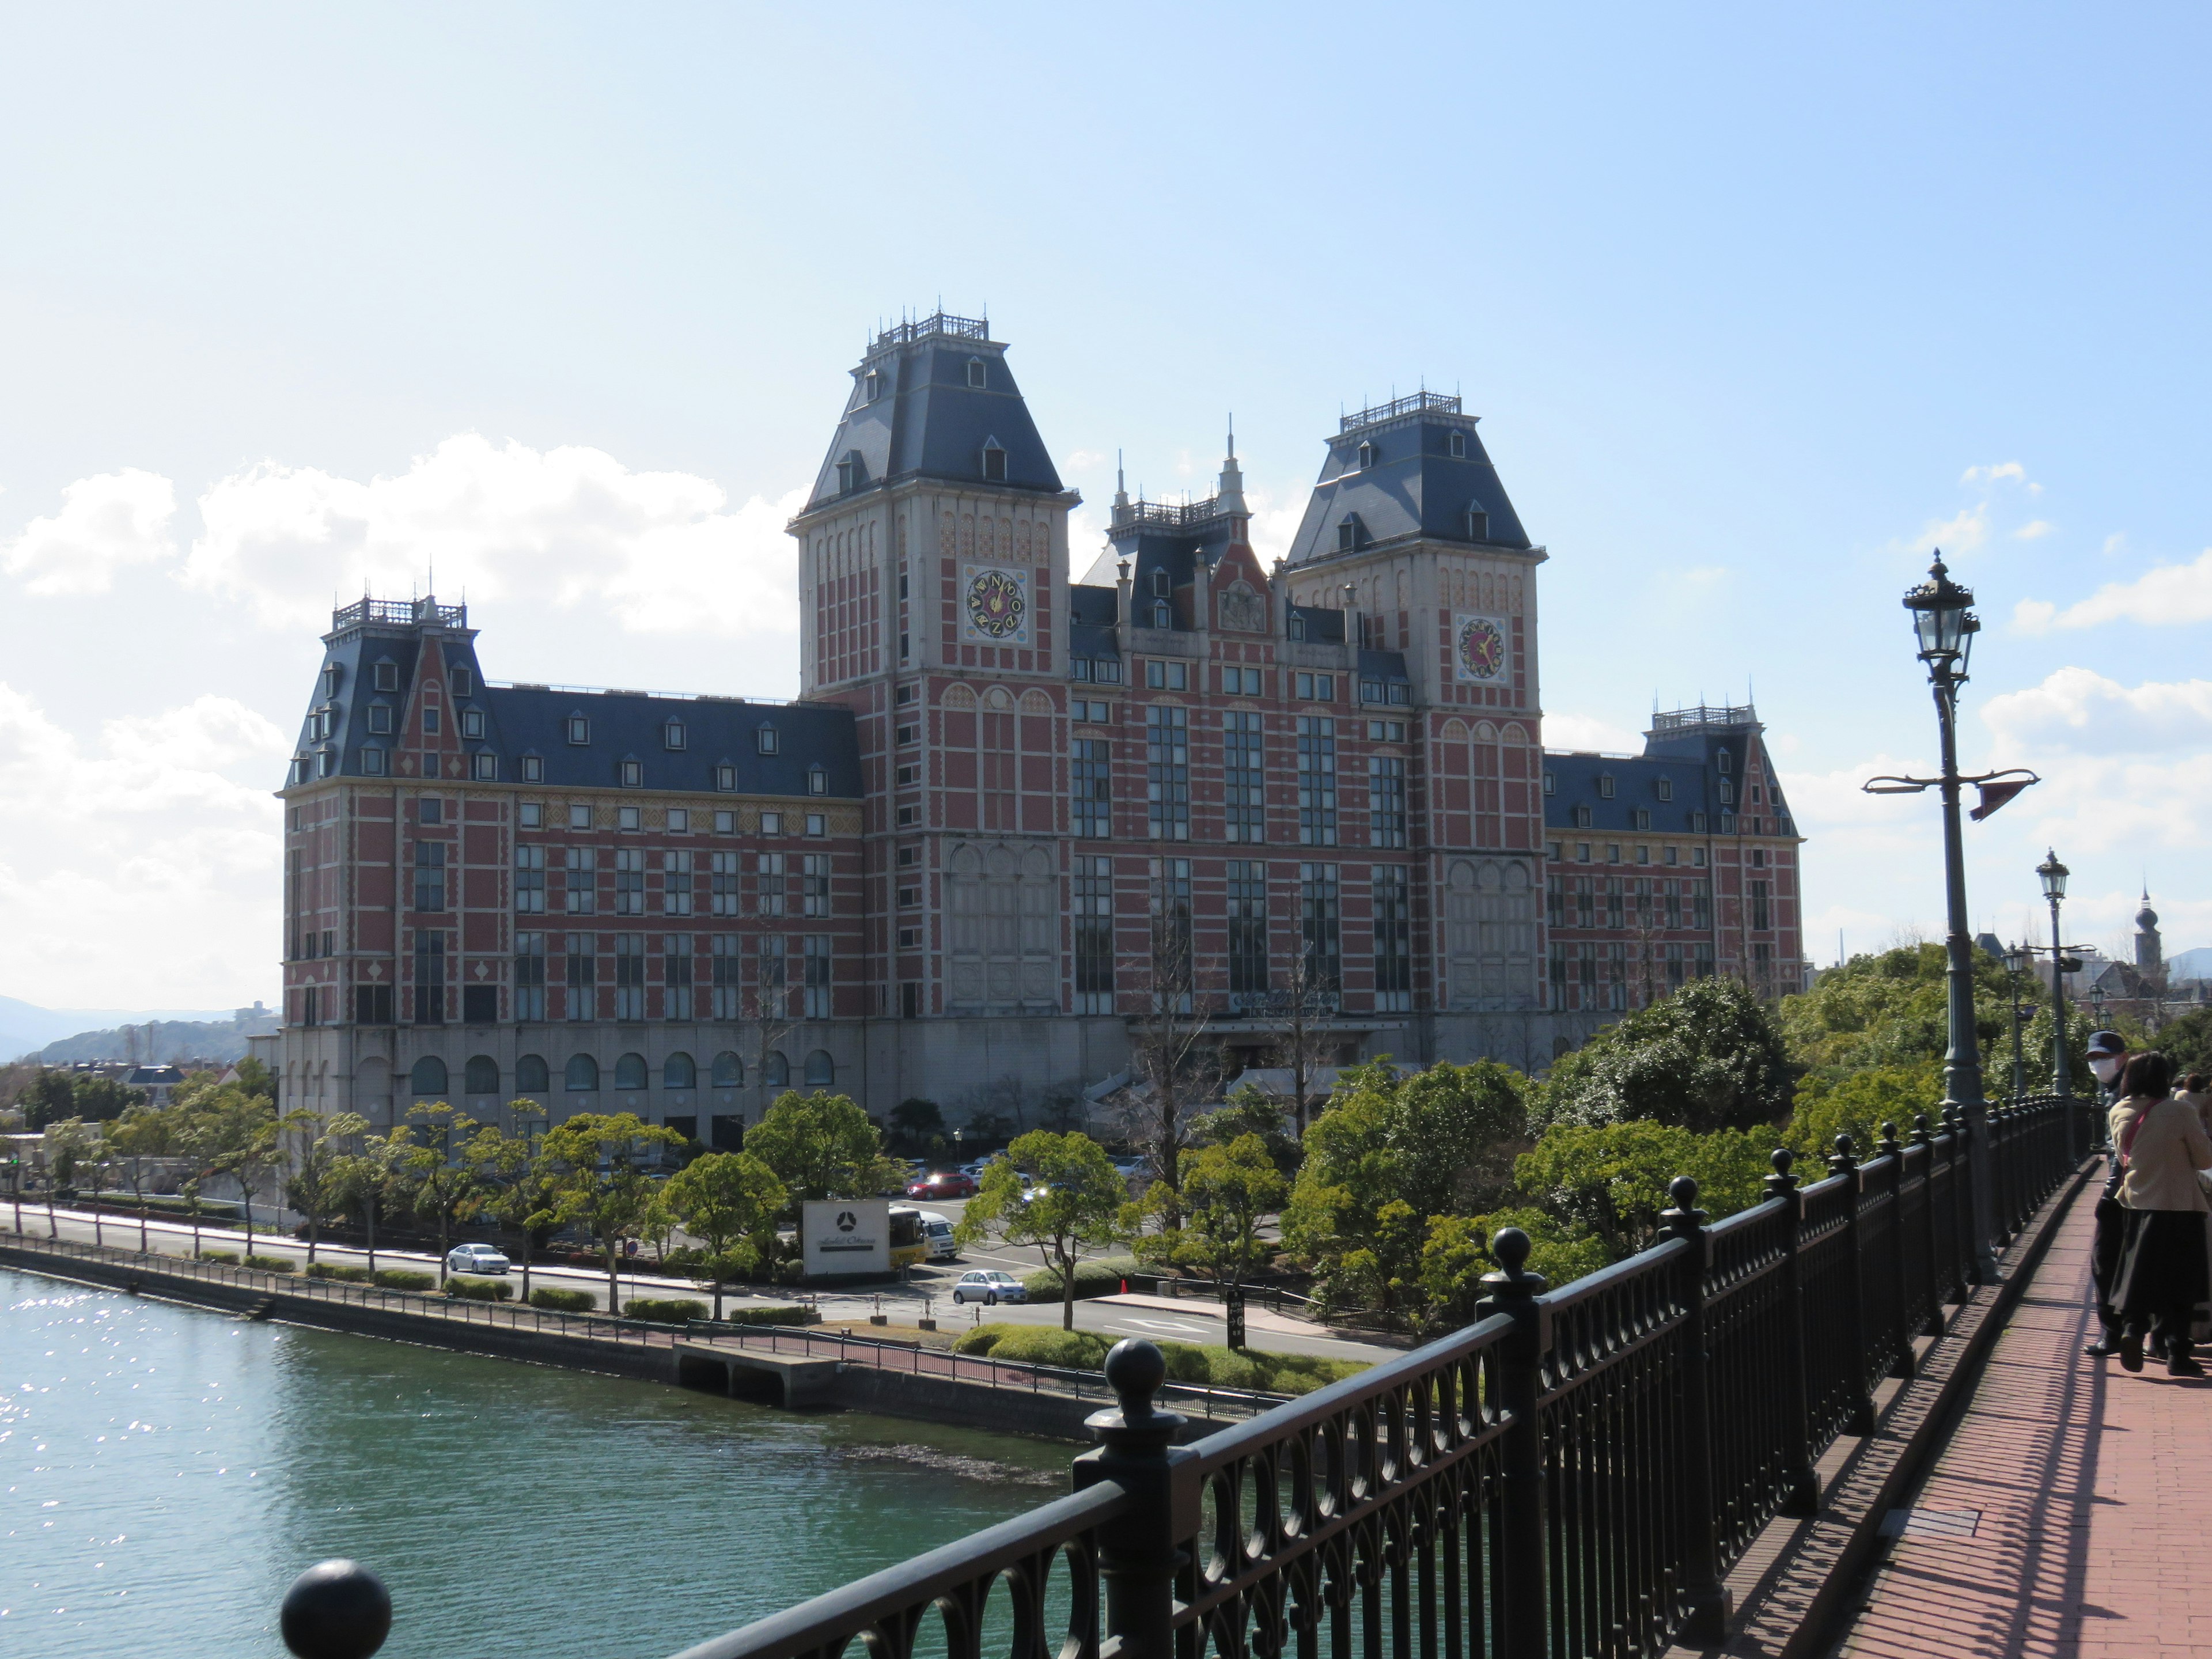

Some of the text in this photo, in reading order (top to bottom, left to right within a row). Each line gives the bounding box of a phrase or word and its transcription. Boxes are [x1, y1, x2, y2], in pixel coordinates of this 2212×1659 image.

[991, 575, 1001, 586] N
[1012, 600, 1021, 611] O
[992, 622, 1001, 634] Z
